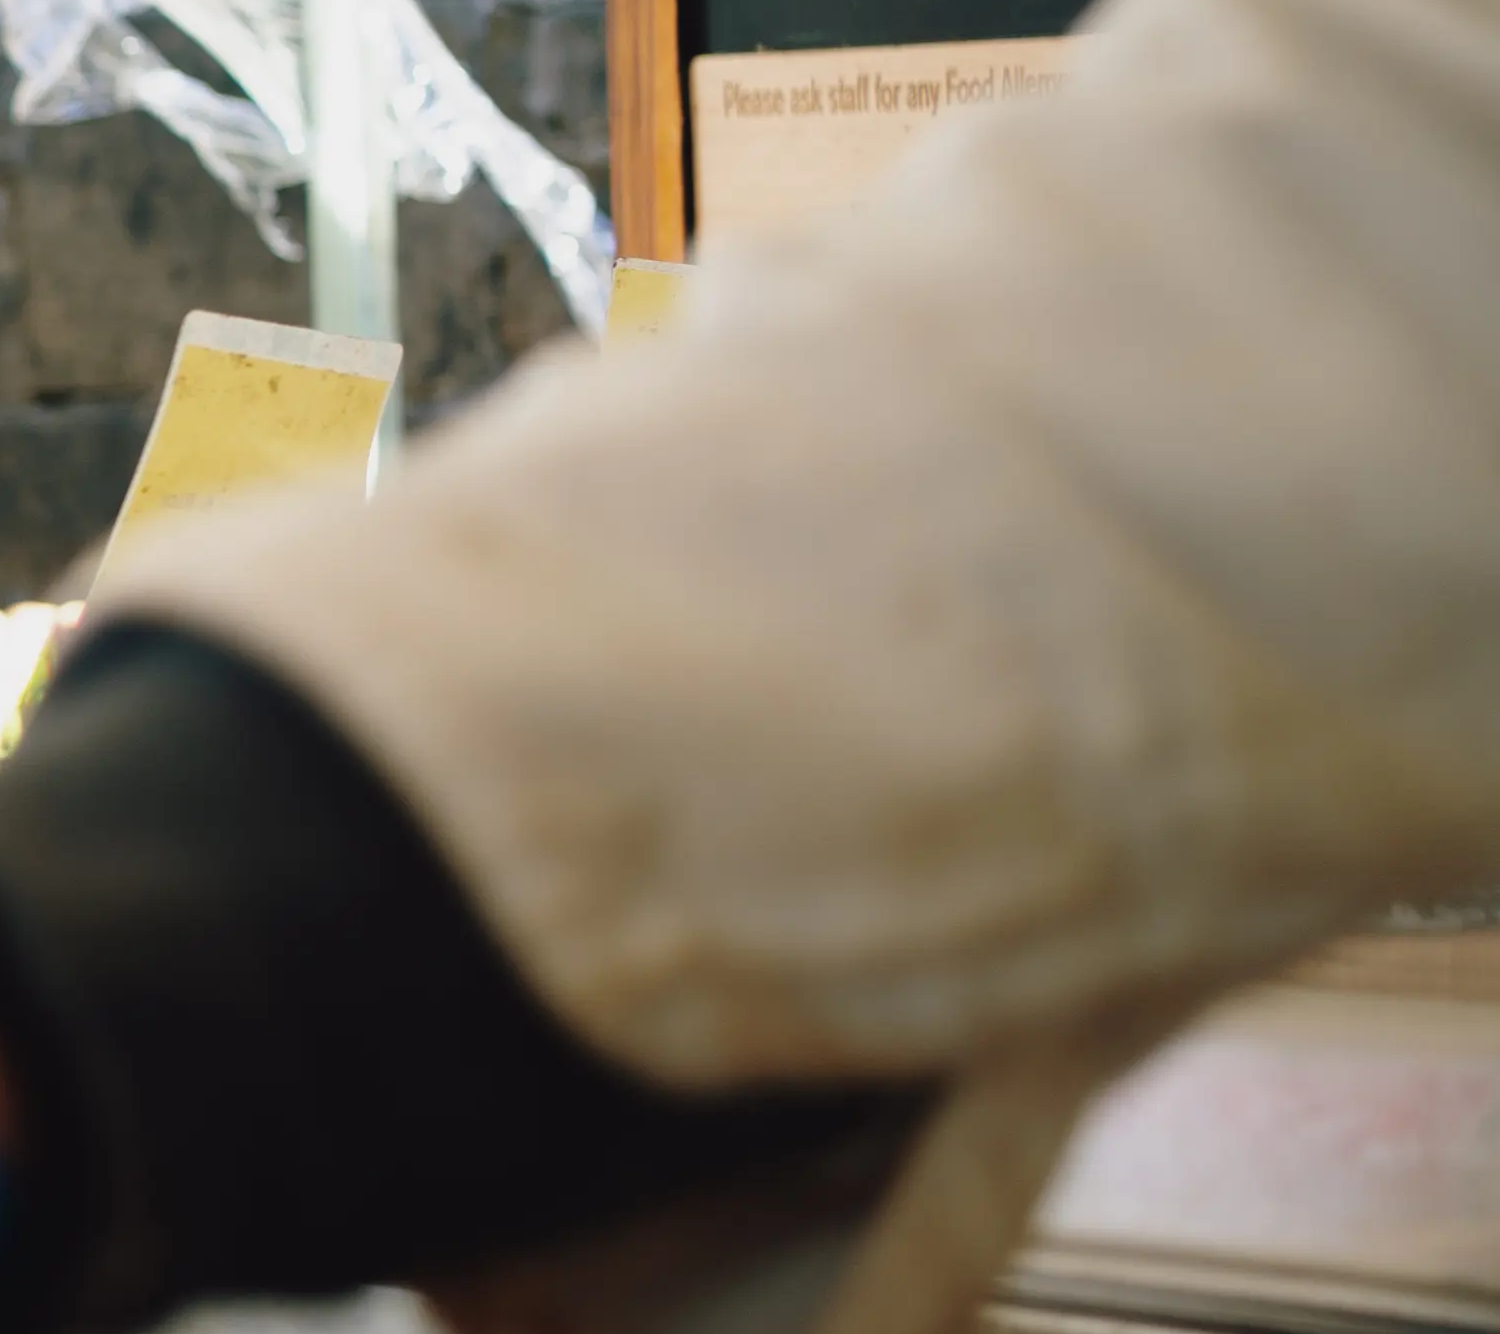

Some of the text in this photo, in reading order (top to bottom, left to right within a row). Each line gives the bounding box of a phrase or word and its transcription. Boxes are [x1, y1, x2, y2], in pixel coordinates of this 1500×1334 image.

[722, 79, 784, 118] Please
[790, 77, 823, 114] ask
[829, 73, 870, 113] staff
[875, 72, 901, 113] for
[906, 78, 940, 115] any
[945, 66, 994, 105] Food
